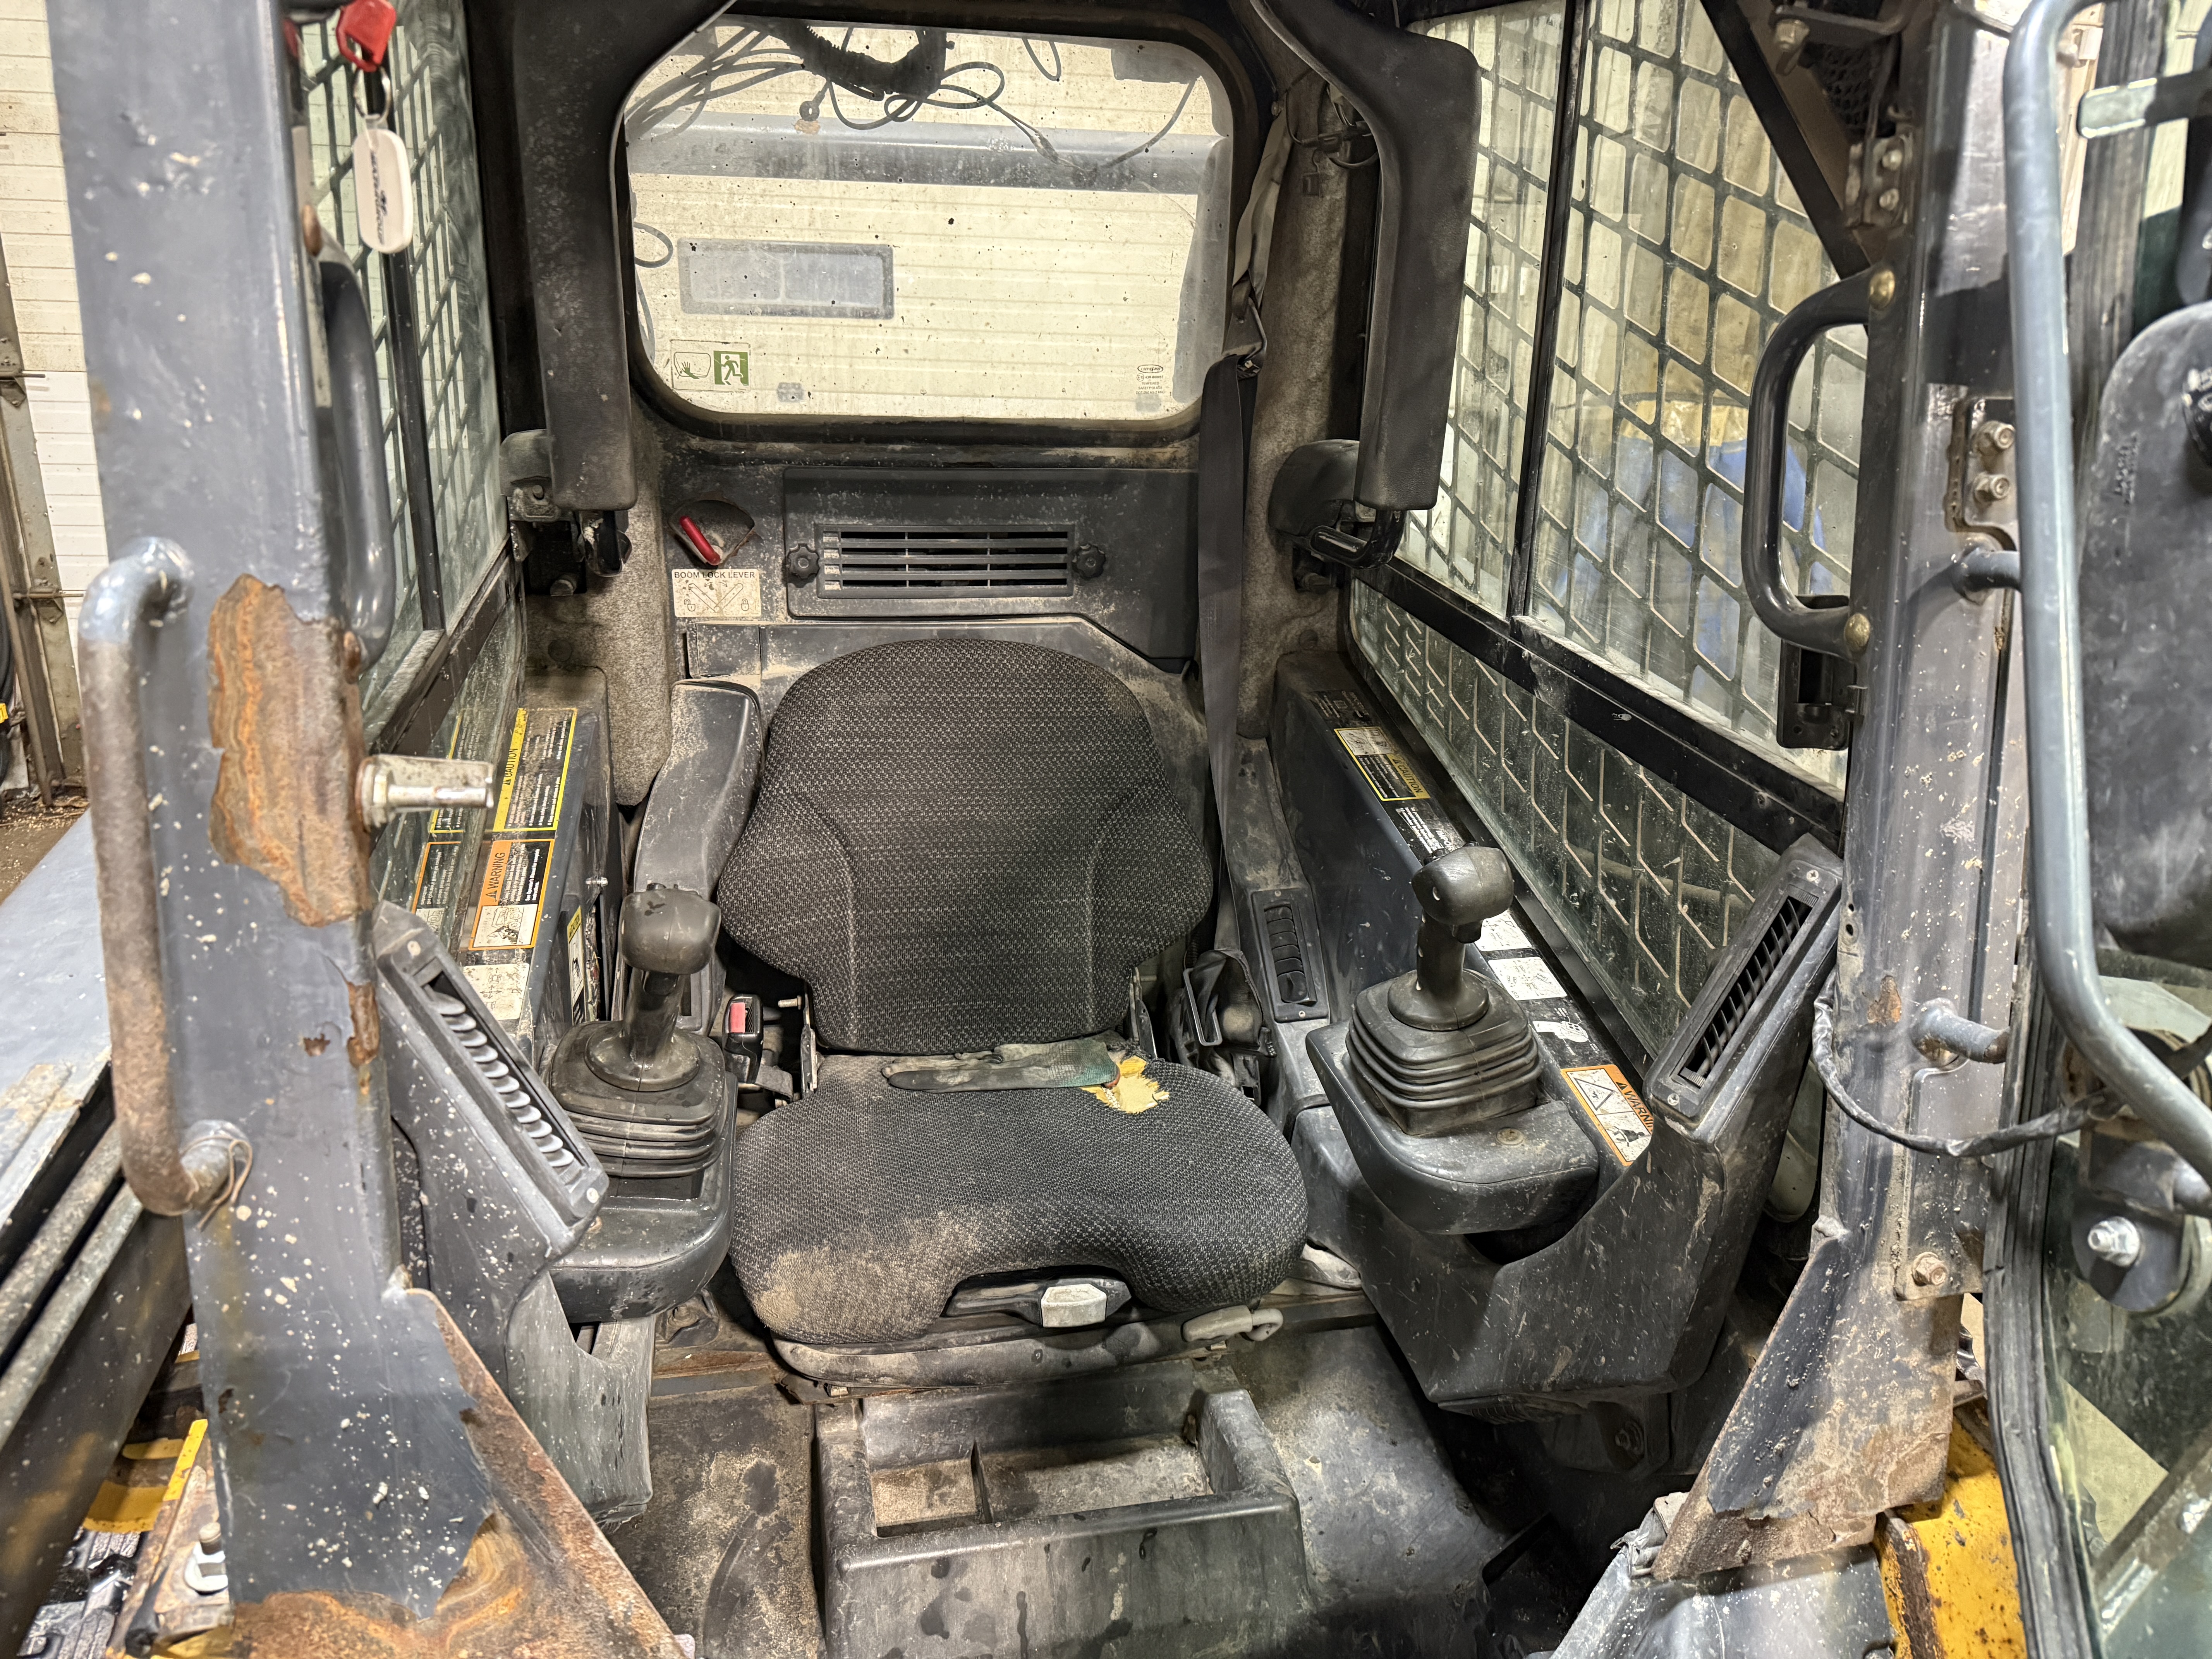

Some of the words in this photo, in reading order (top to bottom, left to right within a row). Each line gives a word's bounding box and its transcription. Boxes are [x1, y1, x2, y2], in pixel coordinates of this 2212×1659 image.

[505, 748, 518, 779] CAUTION
[1398, 765, 1423, 793] CAUTION
[1436, 830, 1455, 852] IMPOR
[488, 852, 505, 891] WARNING
[1624, 1091, 1654, 1132] WARNI
